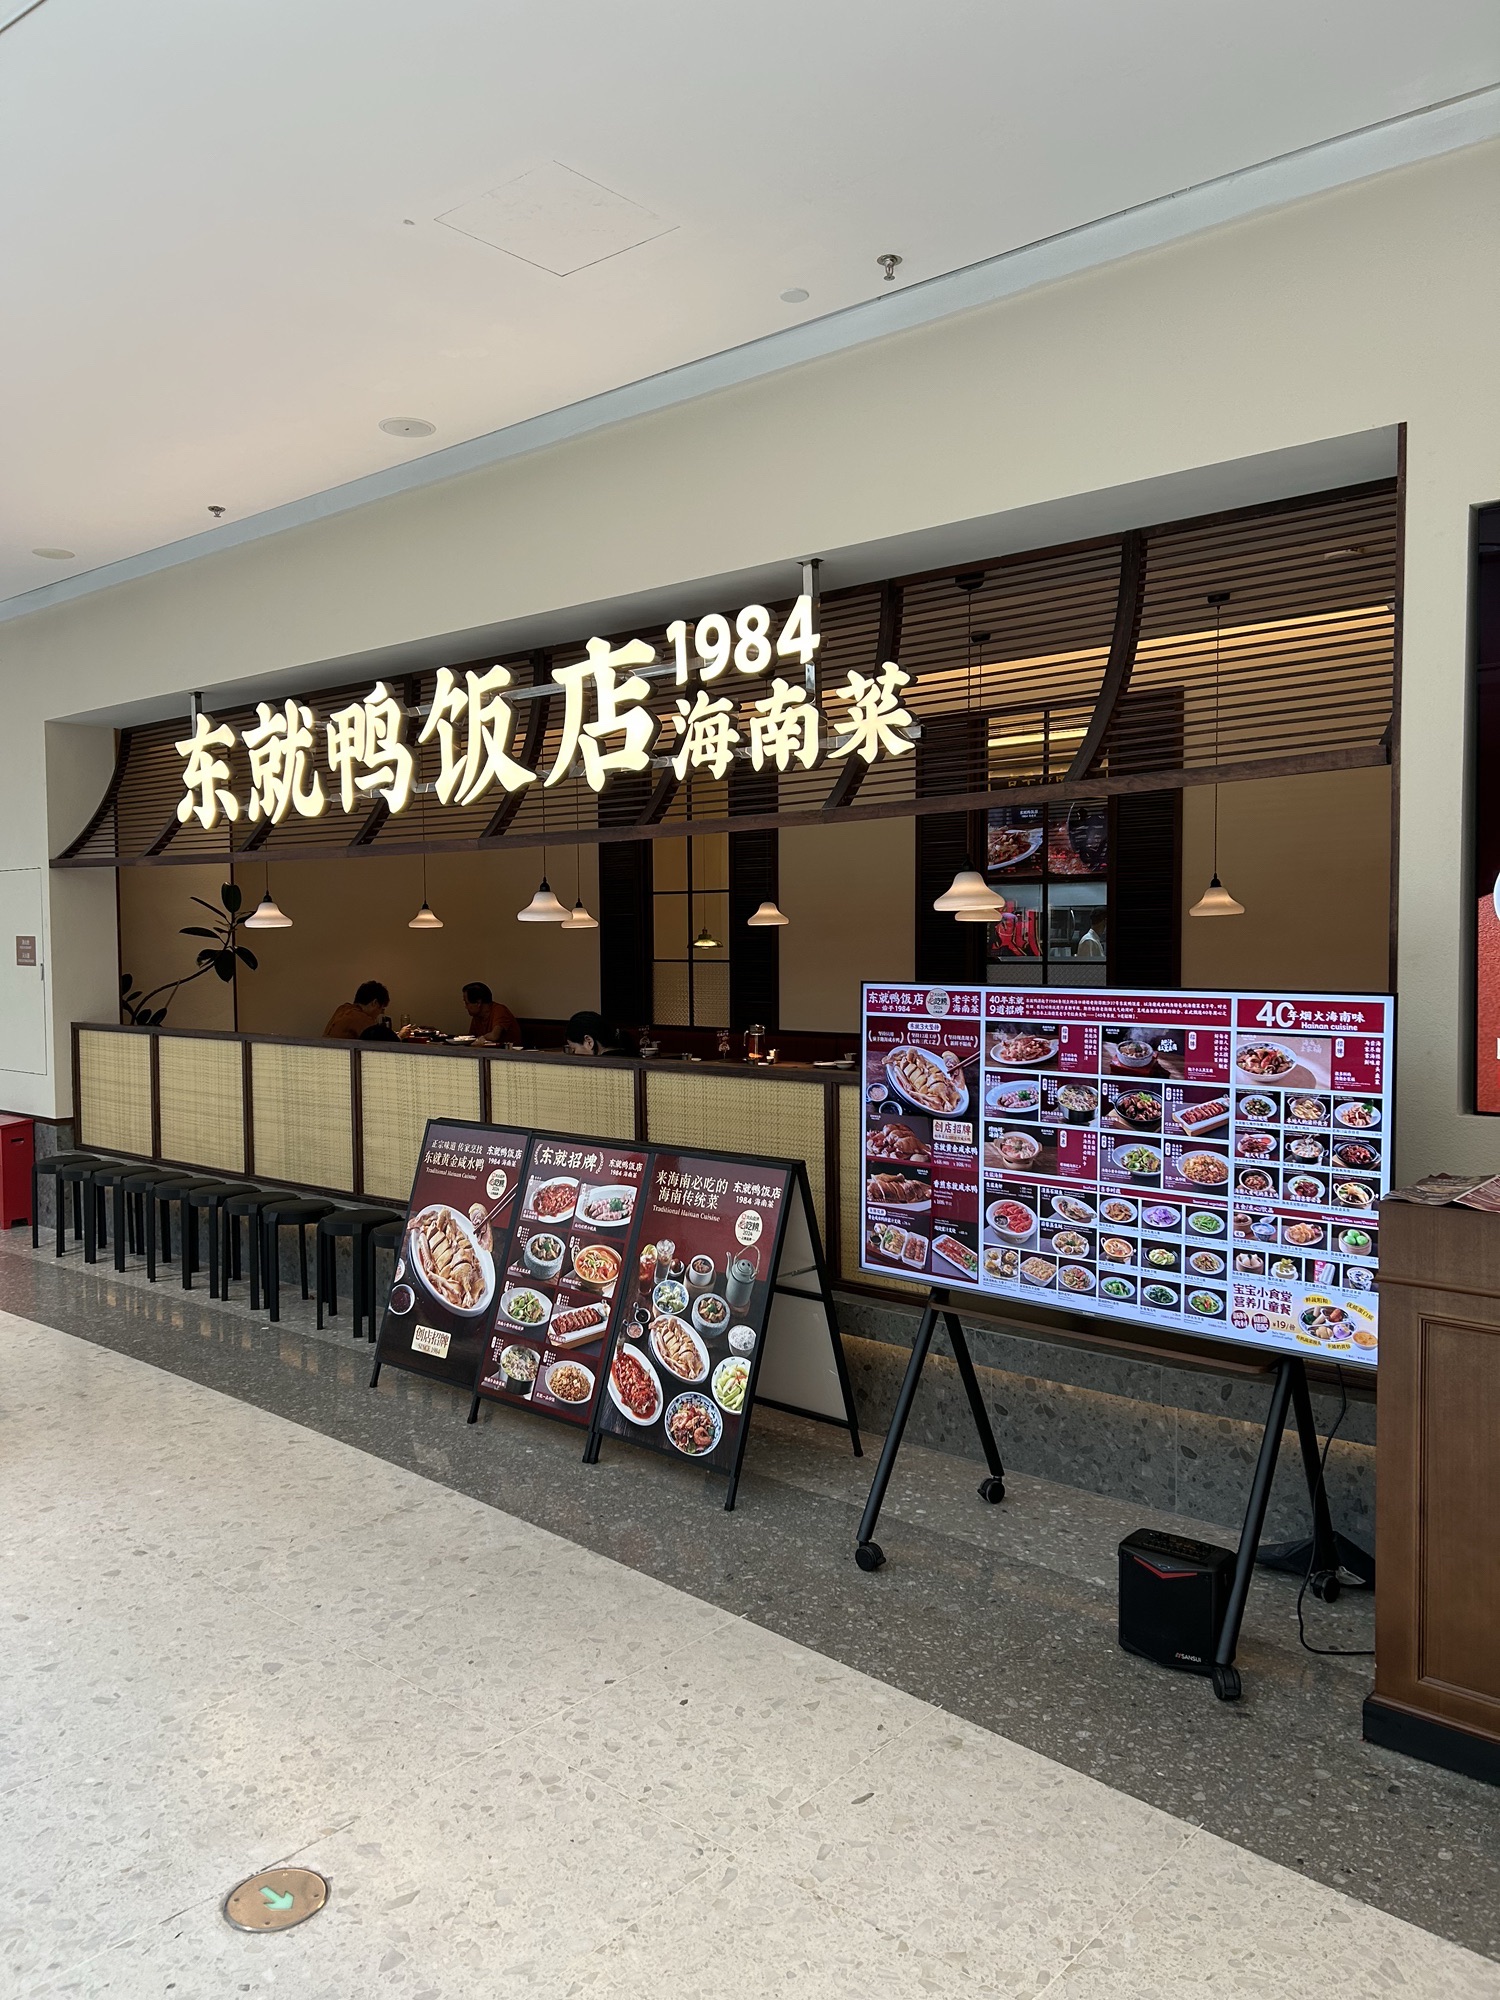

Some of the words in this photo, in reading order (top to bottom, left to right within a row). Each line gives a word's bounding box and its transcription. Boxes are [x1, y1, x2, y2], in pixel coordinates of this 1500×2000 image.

[666, 594, 821, 686] 1984
[670, 661, 918, 783] 海南菜
[174, 636, 660, 831] 东就鸭饭店
[868, 991, 925, 1006] 东就鸭饭店
[952, 995, 979, 1004] 老字号
[989, 995, 1025, 1005] 40年东就
[952, 1005, 979, 1014] 海南菜
[989, 1004, 1025, 1016] 9道招牌
[1301, 1021, 1329, 1030] Hainan
[1330, 1023, 1358, 1032] cuisine
[934, 1121, 972, 1135] 创店招牌
[431, 1139, 457, 1151] 正宗味道
[486, 1145, 523, 1160] 东就鸭饭店
[424, 1150, 485, 1172] 东就黄金咸水鸭
[540, 1146, 598, 1172] 东就招牌
[608, 1157, 644, 1172] 东就鸭饭店
[426, 1166, 447, 1176] Traditional
[655, 1169, 729, 1195] 来海南必吃的
[732, 1180, 782, 1200] 东就鸭饭店
[658, 1186, 720, 1210] 海南传统菜
[652, 1204, 681, 1216] Traditional
[680, 1209, 700, 1219] Hainan
[700, 1212, 721, 1222] Cuisine
[1233, 1283, 1293, 1303] 宝宝小食堂
[1233, 1296, 1292, 1317] 营养儿童餐
